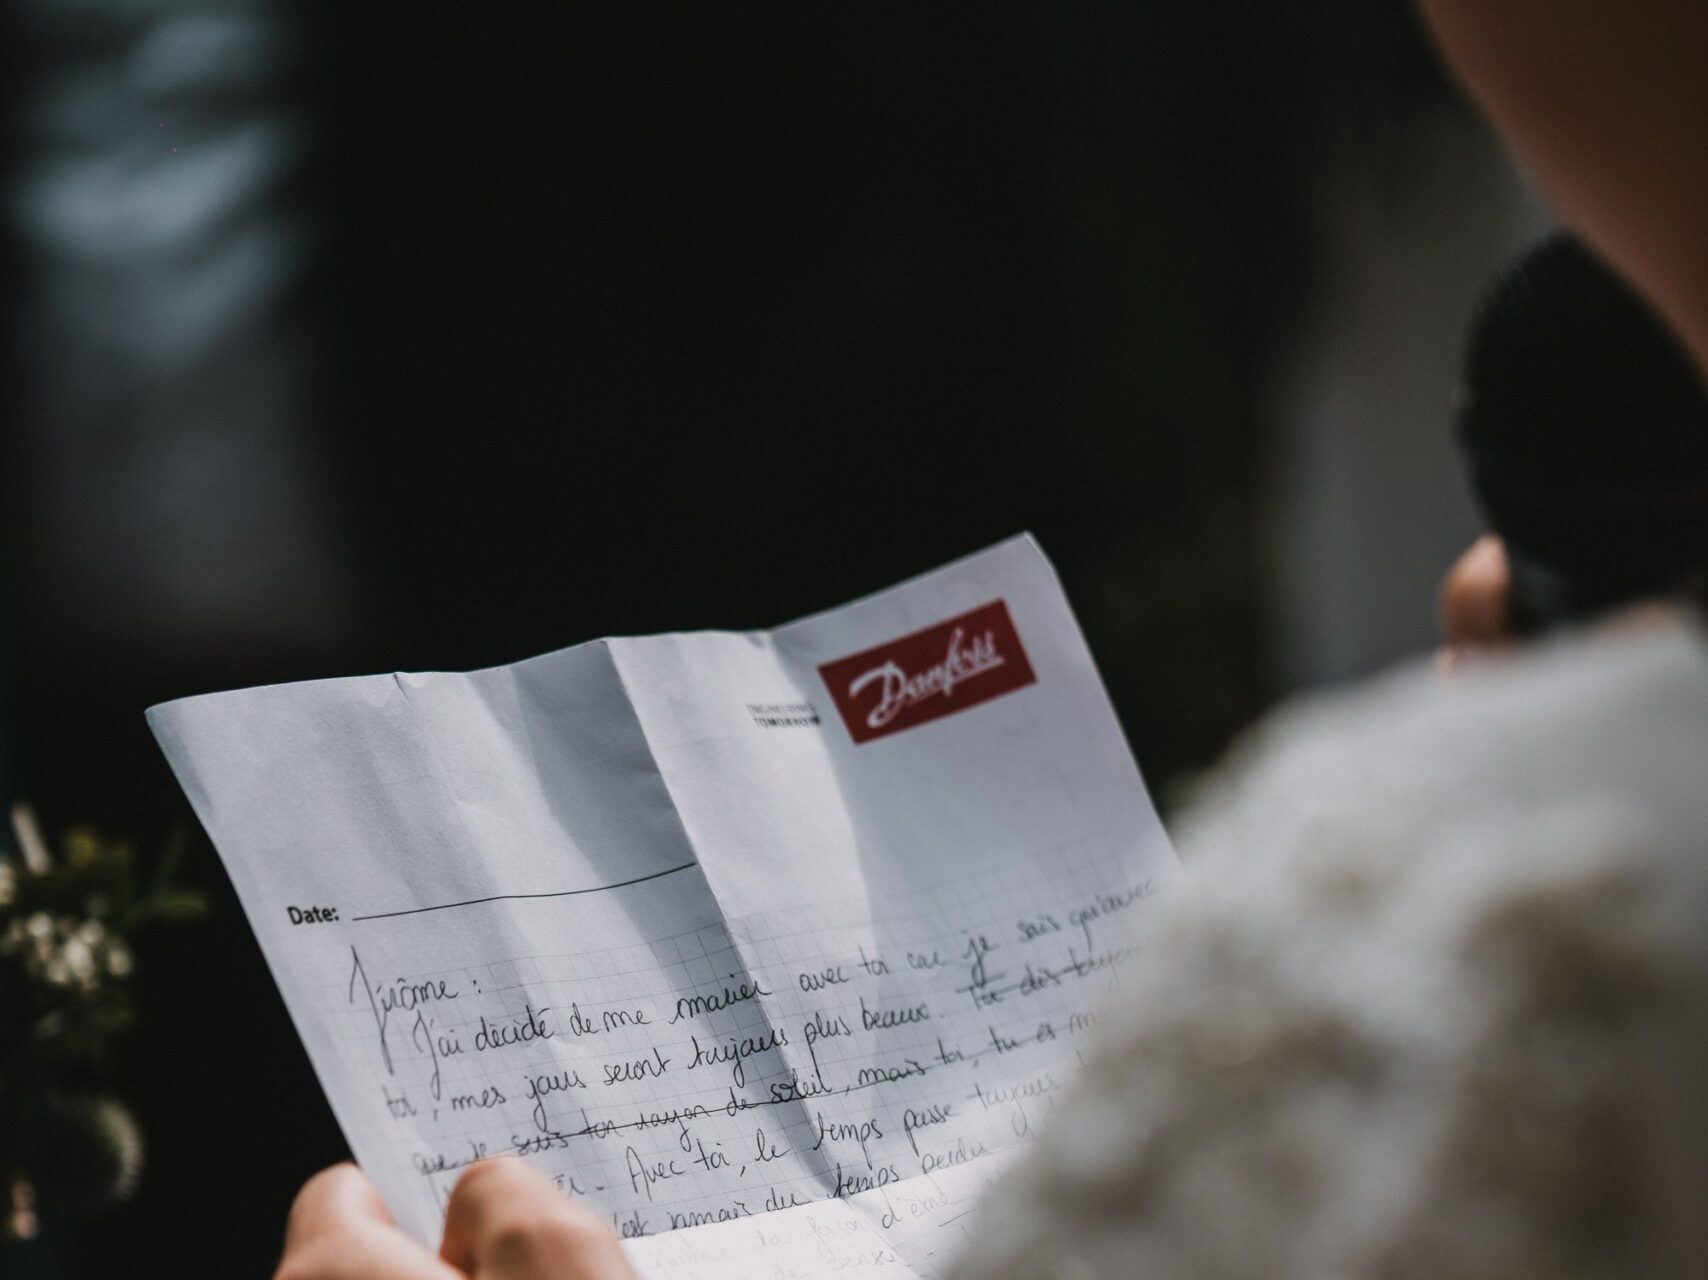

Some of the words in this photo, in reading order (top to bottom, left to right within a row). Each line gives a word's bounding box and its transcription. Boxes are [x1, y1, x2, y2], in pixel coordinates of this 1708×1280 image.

[286, 904, 340, 925] Date:
[474, 1003, 554, 1051] décidé
[570, 1002, 599, 1037] de
[603, 1009, 652, 1032] me
[669, 973, 772, 1025] marier
[799, 966, 849, 992] avec
[857, 945, 890, 976] toi
[906, 951, 946, 969] car
[452, 1086, 506, 1111] mes
[524, 1070, 587, 1133] jours
[603, 1048, 671, 1086] seront
[688, 1028, 789, 1089] toujours
[803, 1011, 852, 1090] plus
[511, 1132, 570, 1157] suis
[578, 1107, 622, 1139] ton
[634, 1104, 711, 1152] rayon
[727, 1086, 757, 1118] de
[857, 1059, 928, 1087] mais
[987, 1025, 1018, 1054] tu
[625, 1145, 685, 1201] Avec
[755, 1128, 792, 1162] le
[813, 1112, 883, 1171] temps
[903, 1103, 957, 1157] passe
[765, 1187, 812, 1213] du
